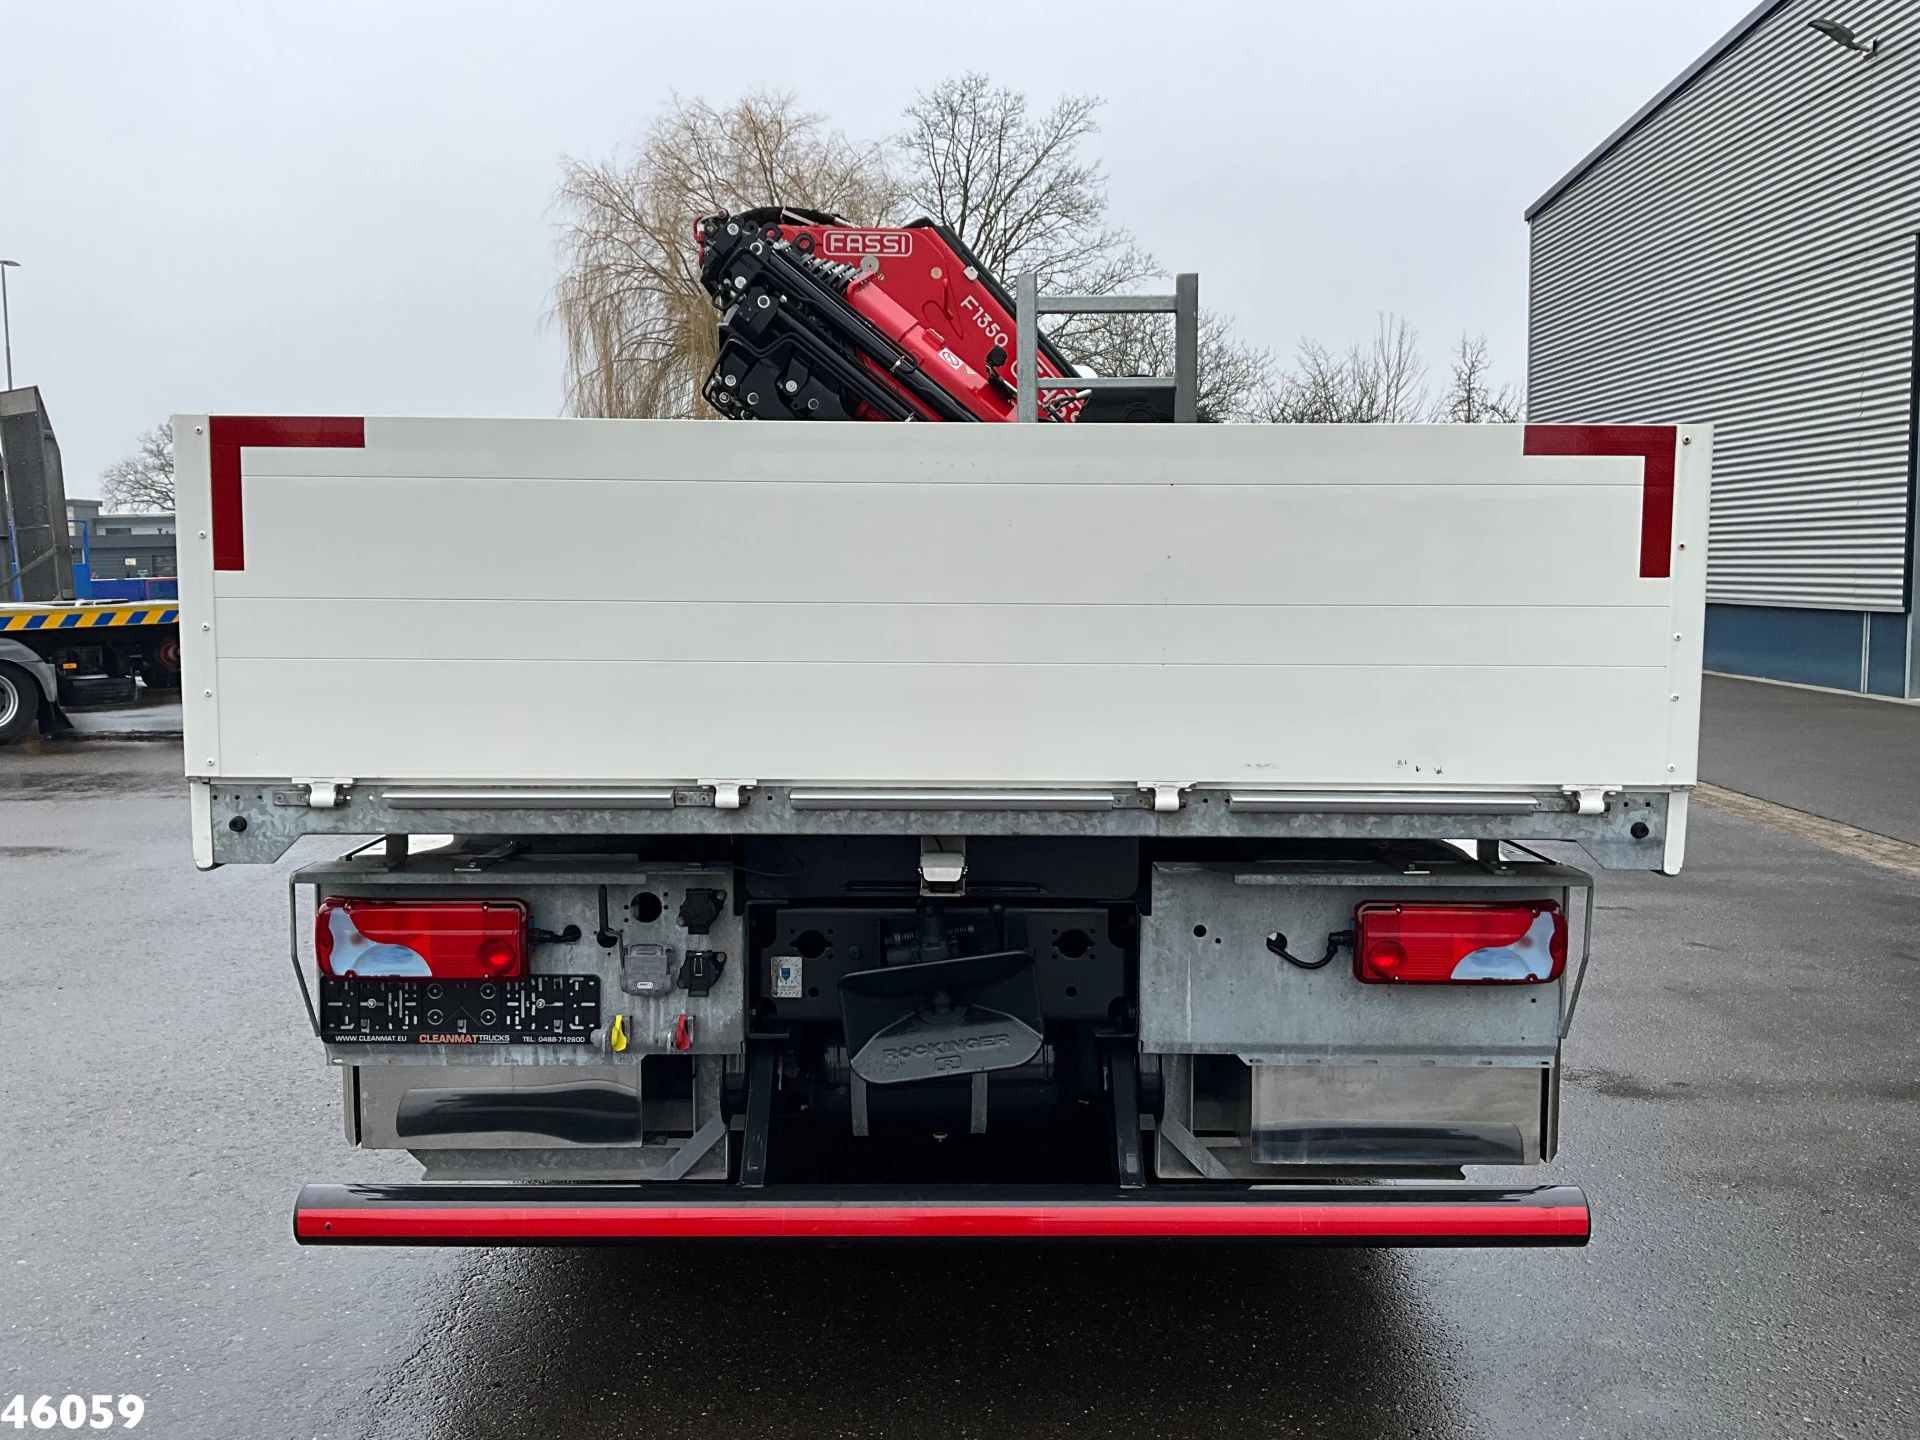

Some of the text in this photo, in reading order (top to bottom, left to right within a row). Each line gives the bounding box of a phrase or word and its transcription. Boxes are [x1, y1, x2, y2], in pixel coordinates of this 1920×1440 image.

[830, 234, 906, 253] FASSI
[960, 295, 1009, 348] F1350
[882, 1034, 1010, 1061] ROCKINGER
